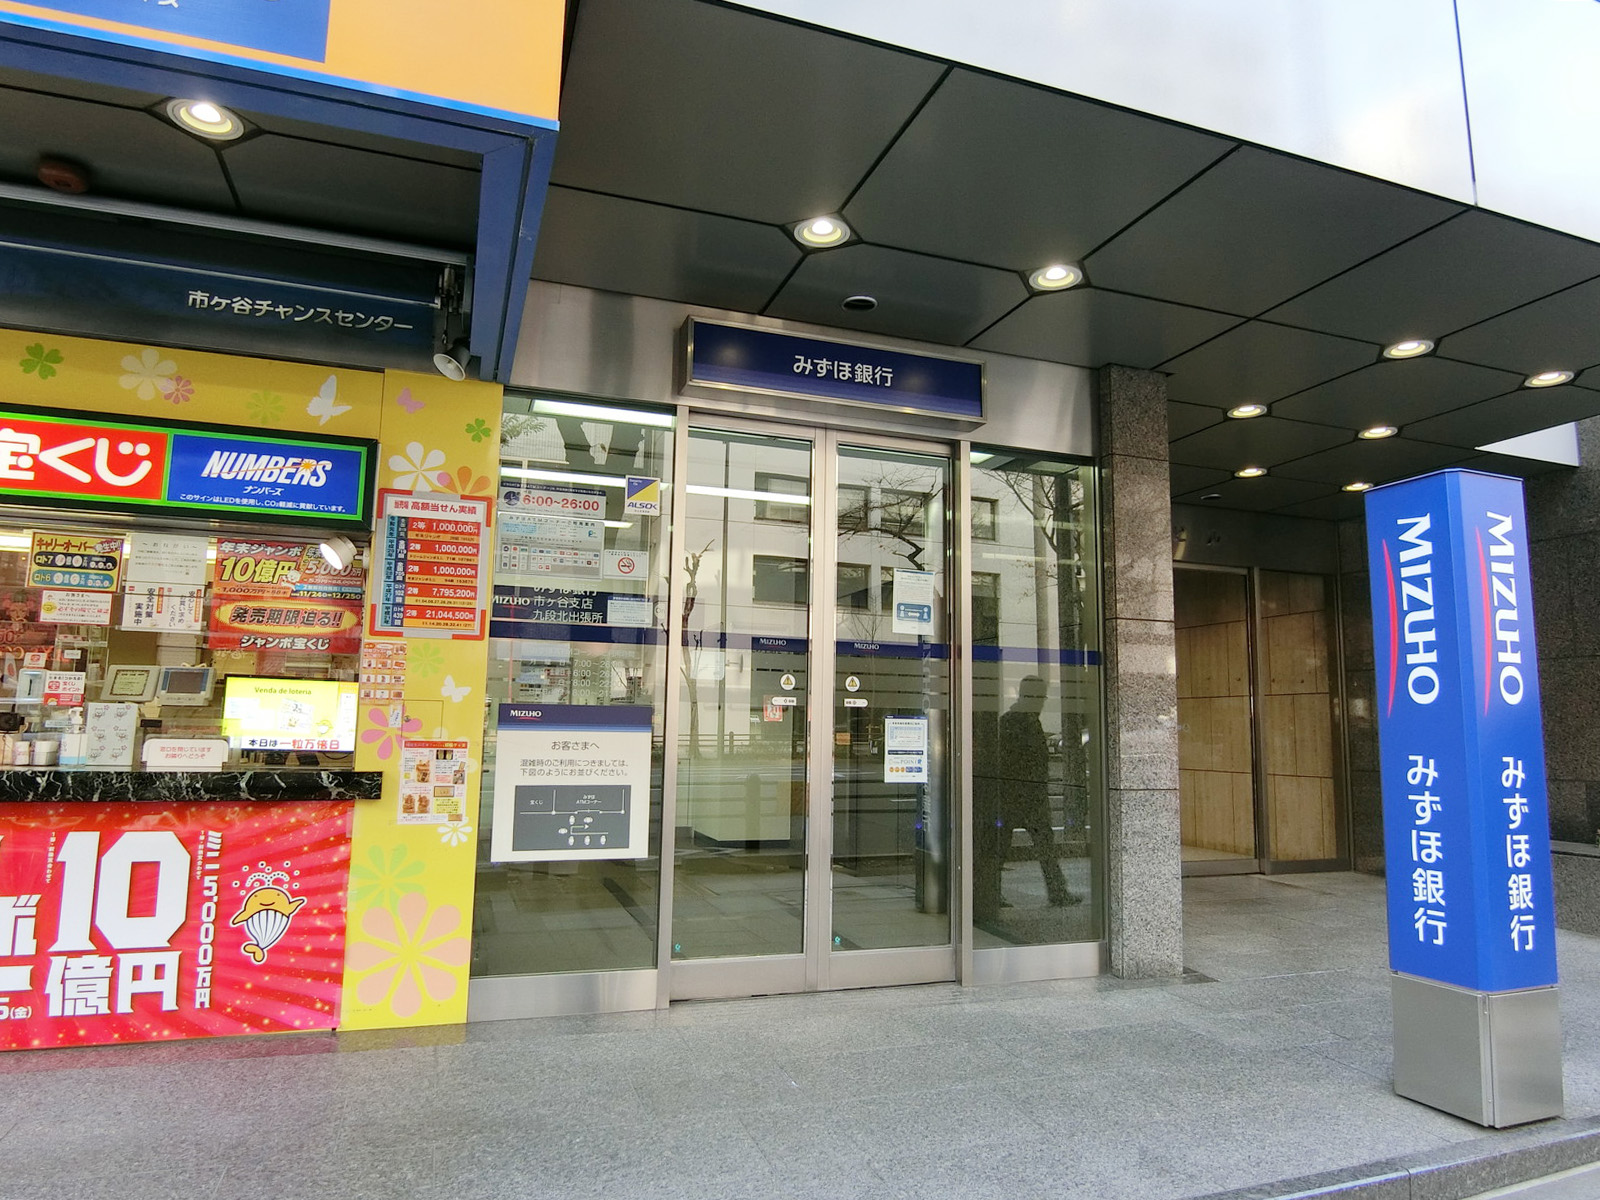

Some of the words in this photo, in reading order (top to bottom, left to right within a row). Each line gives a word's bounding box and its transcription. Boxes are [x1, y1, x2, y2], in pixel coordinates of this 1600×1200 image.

[793, 355, 894, 387] みずほ銀行
[201, 450, 332, 487] NUMBERS
[243, 485, 284, 496] ナンバーズ
[627, 502, 657, 511] ALSOK
[36, 538, 95, 551] キャリーオーバー
[220, 541, 302, 556] 年末ジャンボ
[35, 555, 54, 564] ロト7
[220, 556, 297, 585] 10億円
[1396, 512, 1440, 706] MIZUHO
[1486, 511, 1524, 706] MIZUHO
[532, 610, 604, 623] 九段北出張所
[241, 635, 330, 650] ジャンボ宝くじ
[760, 638, 786, 646] MIZUHO
[854, 642, 879, 650] MIZUHO
[254, 686, 276, 694] Venda
[289, 687, 312, 695] loteria
[248, 739, 340, 750] 本日は一粒万倍日
[551, 741, 600, 751] お客さまへ
[520, 759, 629, 767] 混雑時のご利用につきましては、
[520, 768, 628, 777] 下図のようにお並びください。
[1406, 755, 1448, 946] みずほ銀行
[1501, 756, 1535, 952] みずほ銀行
[48, 831, 191, 951] 10
[45, 951, 182, 1016] 億円
